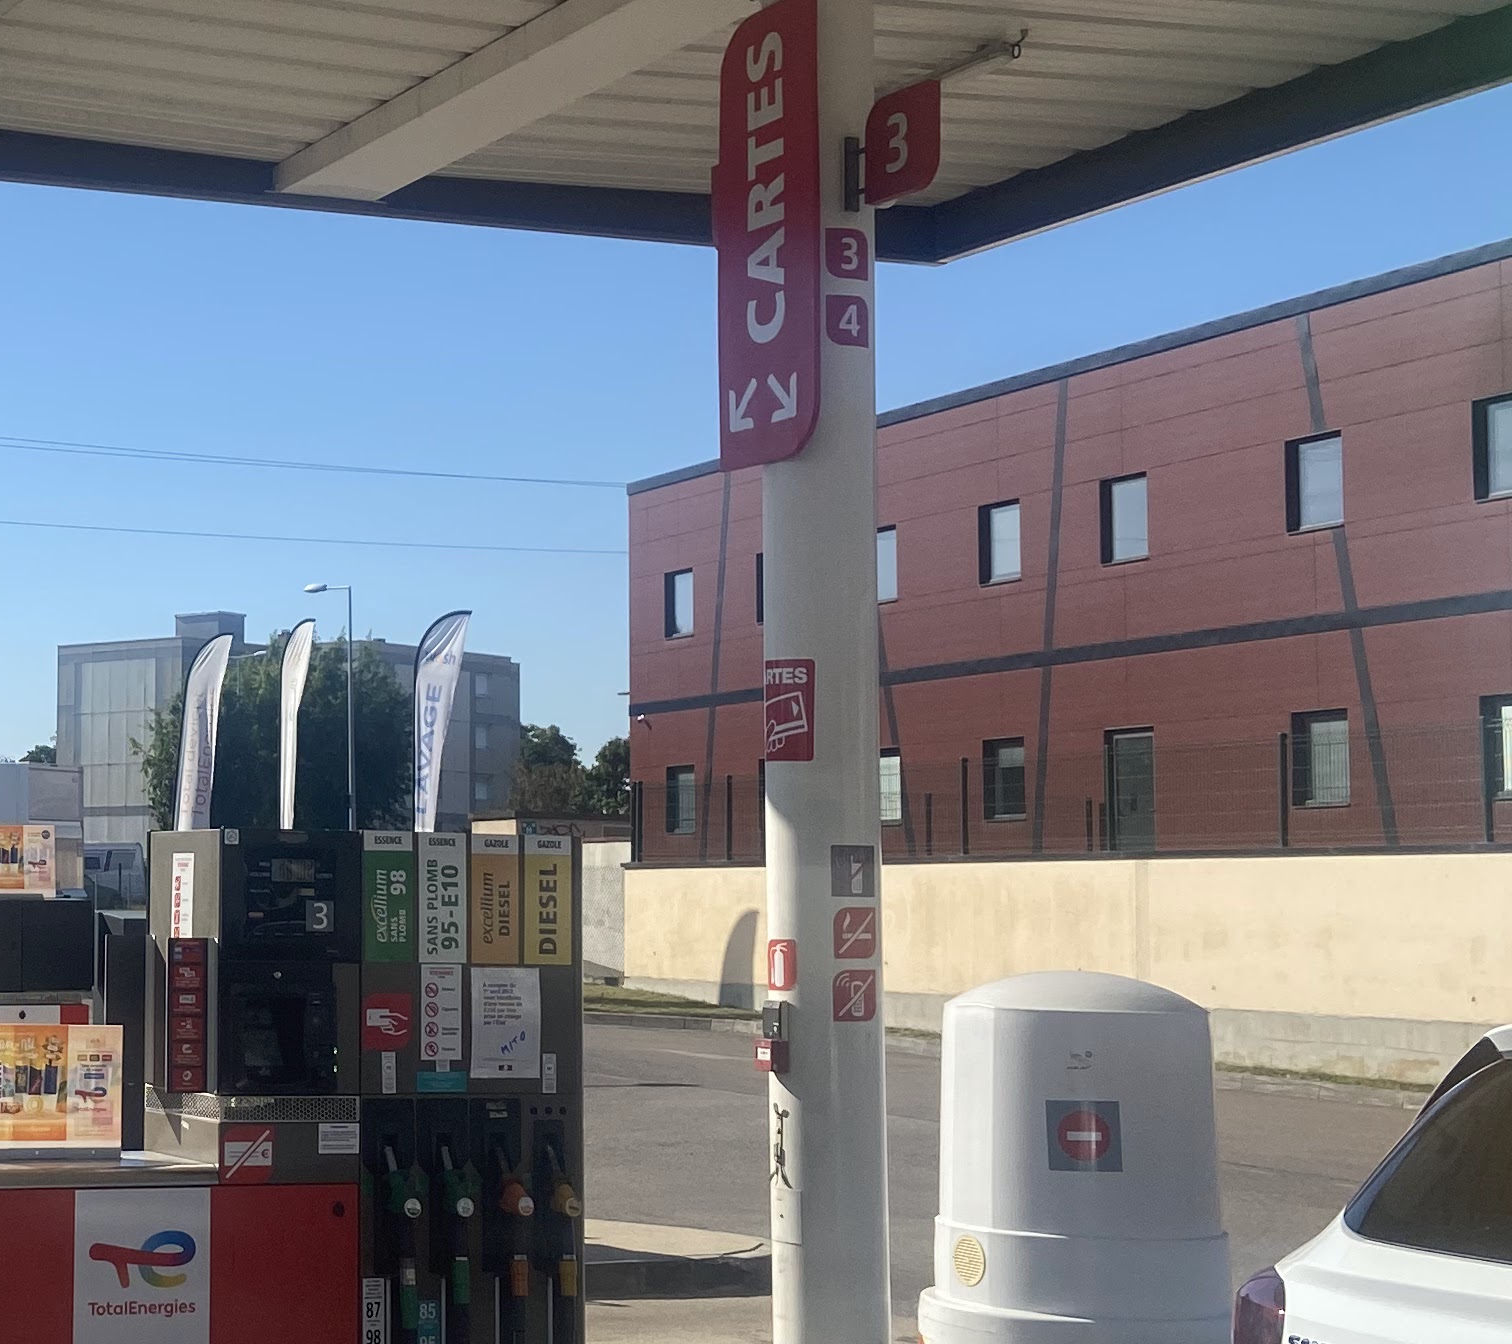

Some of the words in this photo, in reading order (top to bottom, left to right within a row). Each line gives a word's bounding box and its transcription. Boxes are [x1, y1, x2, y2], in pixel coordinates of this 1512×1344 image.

[885, 111, 910, 174] 3
[746, 30, 786, 344] CARTES
[841, 237, 859, 270] 3
[839, 304, 861, 337] 4
[765, 667, 808, 685] RTES
[415, 683, 443, 815] LAVAGE
[374, 835, 403, 845] ESSENCE
[428, 837, 456, 847] ESSENCE
[484, 839, 509, 849] GAZOLE
[537, 840, 562, 849] GAZOLE
[389, 869, 407, 895] 98
[426, 859, 438, 911] PLOMB
[312, 902, 328, 929] 3
[371, 869, 388, 943] excellium
[441, 864, 459, 950] 95-E10
[479, 872, 493, 944] excellium
[498, 880, 511, 937] DIESEL
[539, 863, 558, 955] DIESEL
[390, 916, 398, 943] SANS
[399, 909, 407, 943] PLOMB
[426, 915, 438, 955] SANS
[87, 1298, 196, 1318] TotalEnergies
[366, 1301, 381, 1318] 87
[419, 1302, 436, 1319] 85
